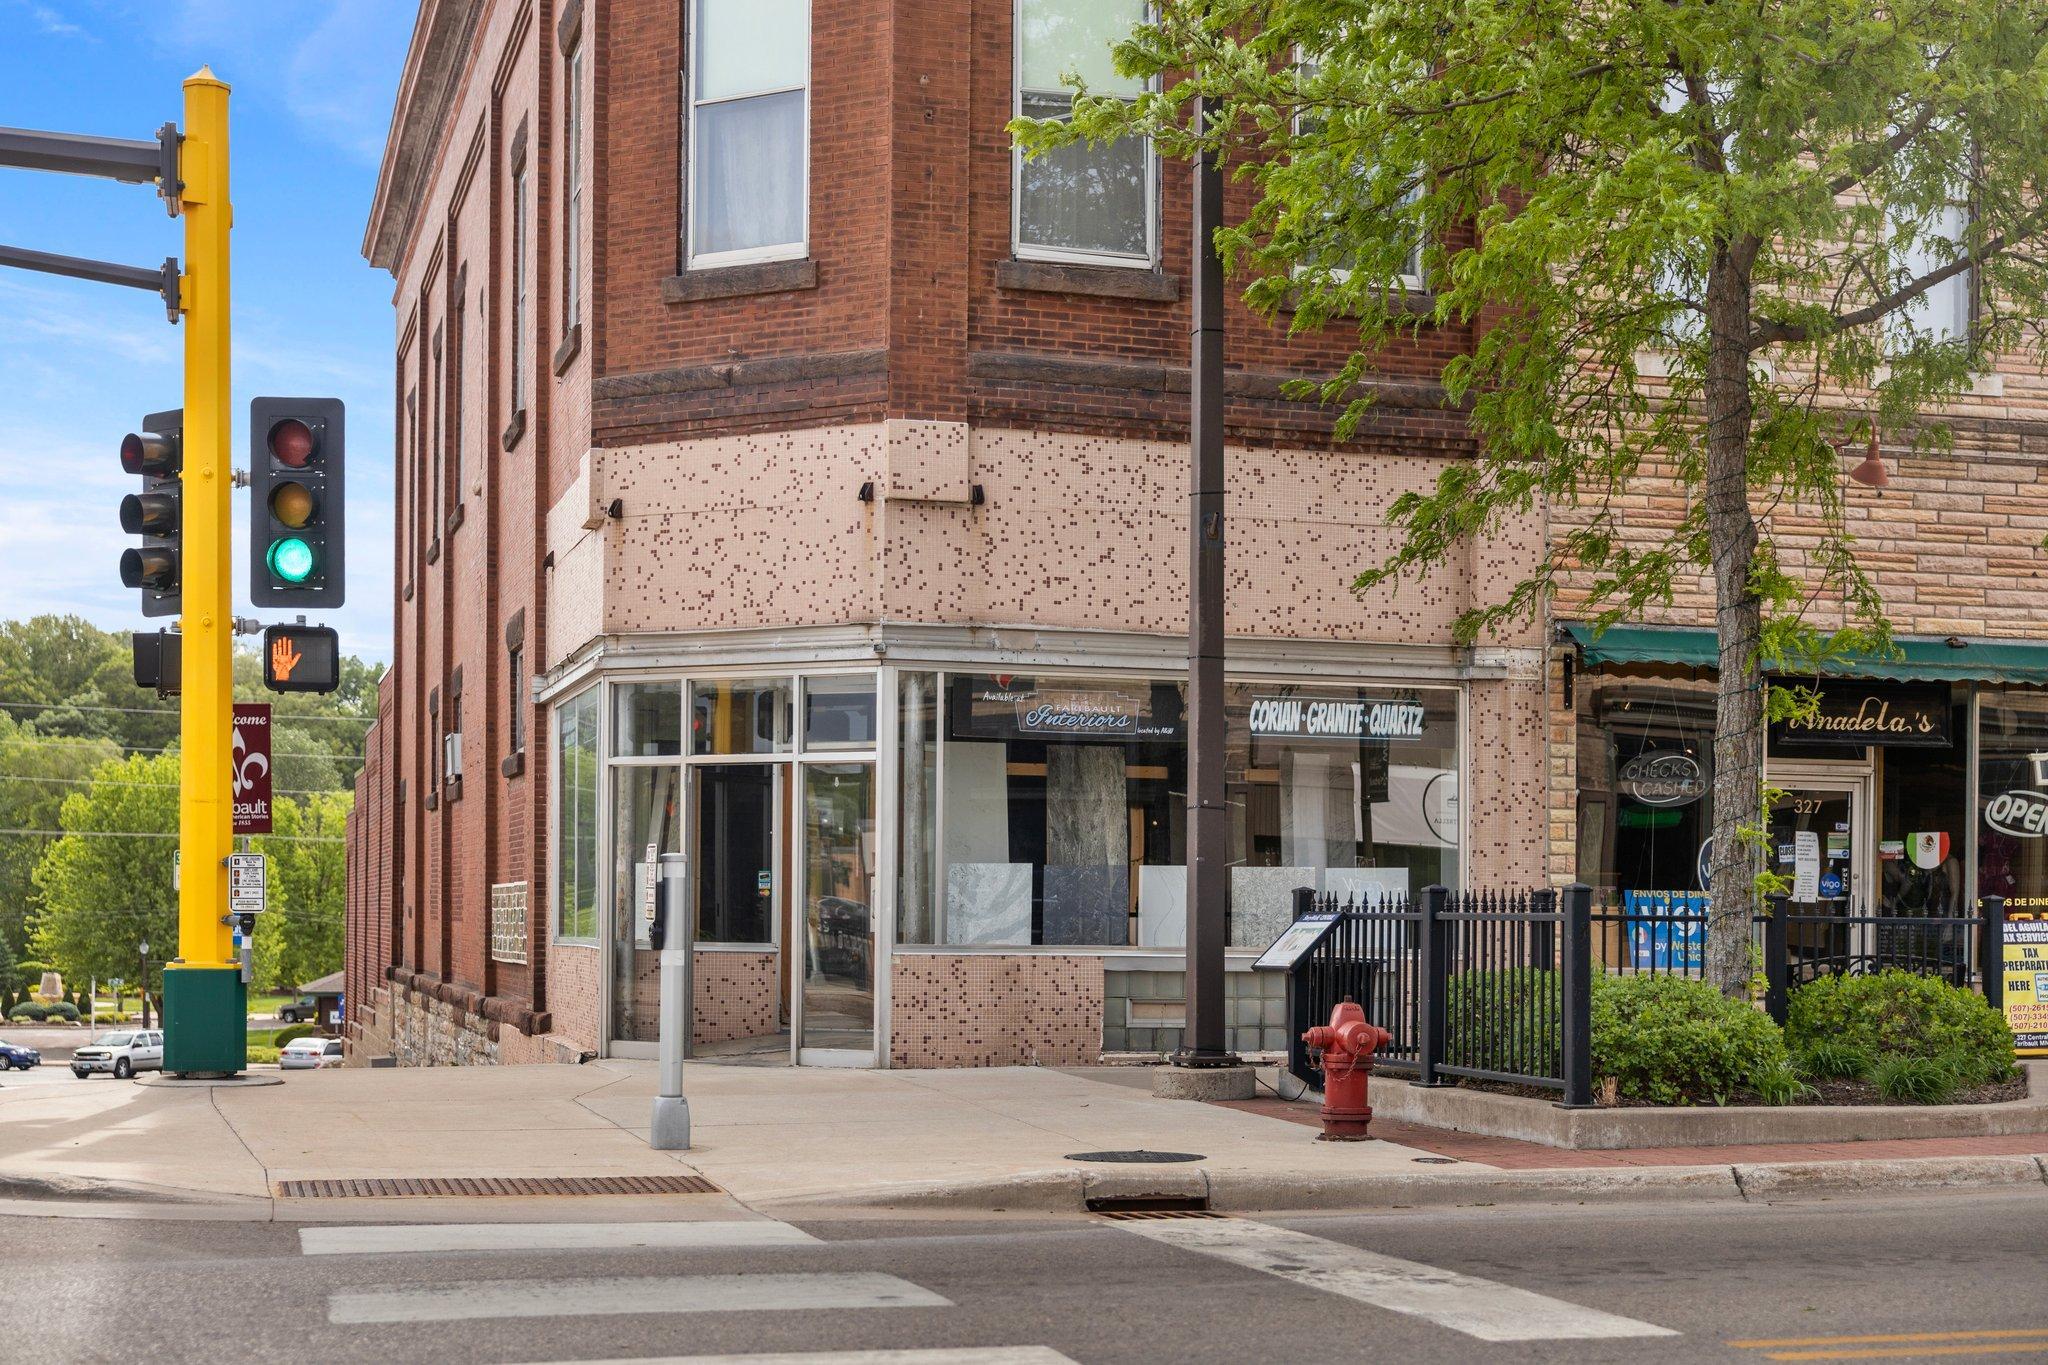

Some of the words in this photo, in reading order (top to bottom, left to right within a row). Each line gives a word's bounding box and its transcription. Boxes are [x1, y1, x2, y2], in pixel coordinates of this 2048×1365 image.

[1056, 704, 1121, 713] FARIBAULT
[1789, 697, 1935, 733] Anadela's
[232, 711, 267, 725] come
[1026, 704, 1131, 728] Interiors
[1250, 700, 1302, 732] CORIAN
[1306, 702, 1365, 735] GRANITE
[1369, 704, 1424, 736] QUARTZ
[1626, 762, 1691, 779] CHECKS
[1641, 780, 1705, 796] CASHED
[1793, 799, 1822, 814] 327
[1633, 890, 1670, 898] ENVIOS
[1672, 890, 1686, 898] DE
[1687, 890, 1712, 899] DINE
[2014, 898, 2027, 906] DE
[2003, 932, 2016, 942] AX
[2016, 932, 2048, 943] SERVIC
[2022, 948, 2039, 958] TAX
[2008, 981, 2030, 991] HERE
